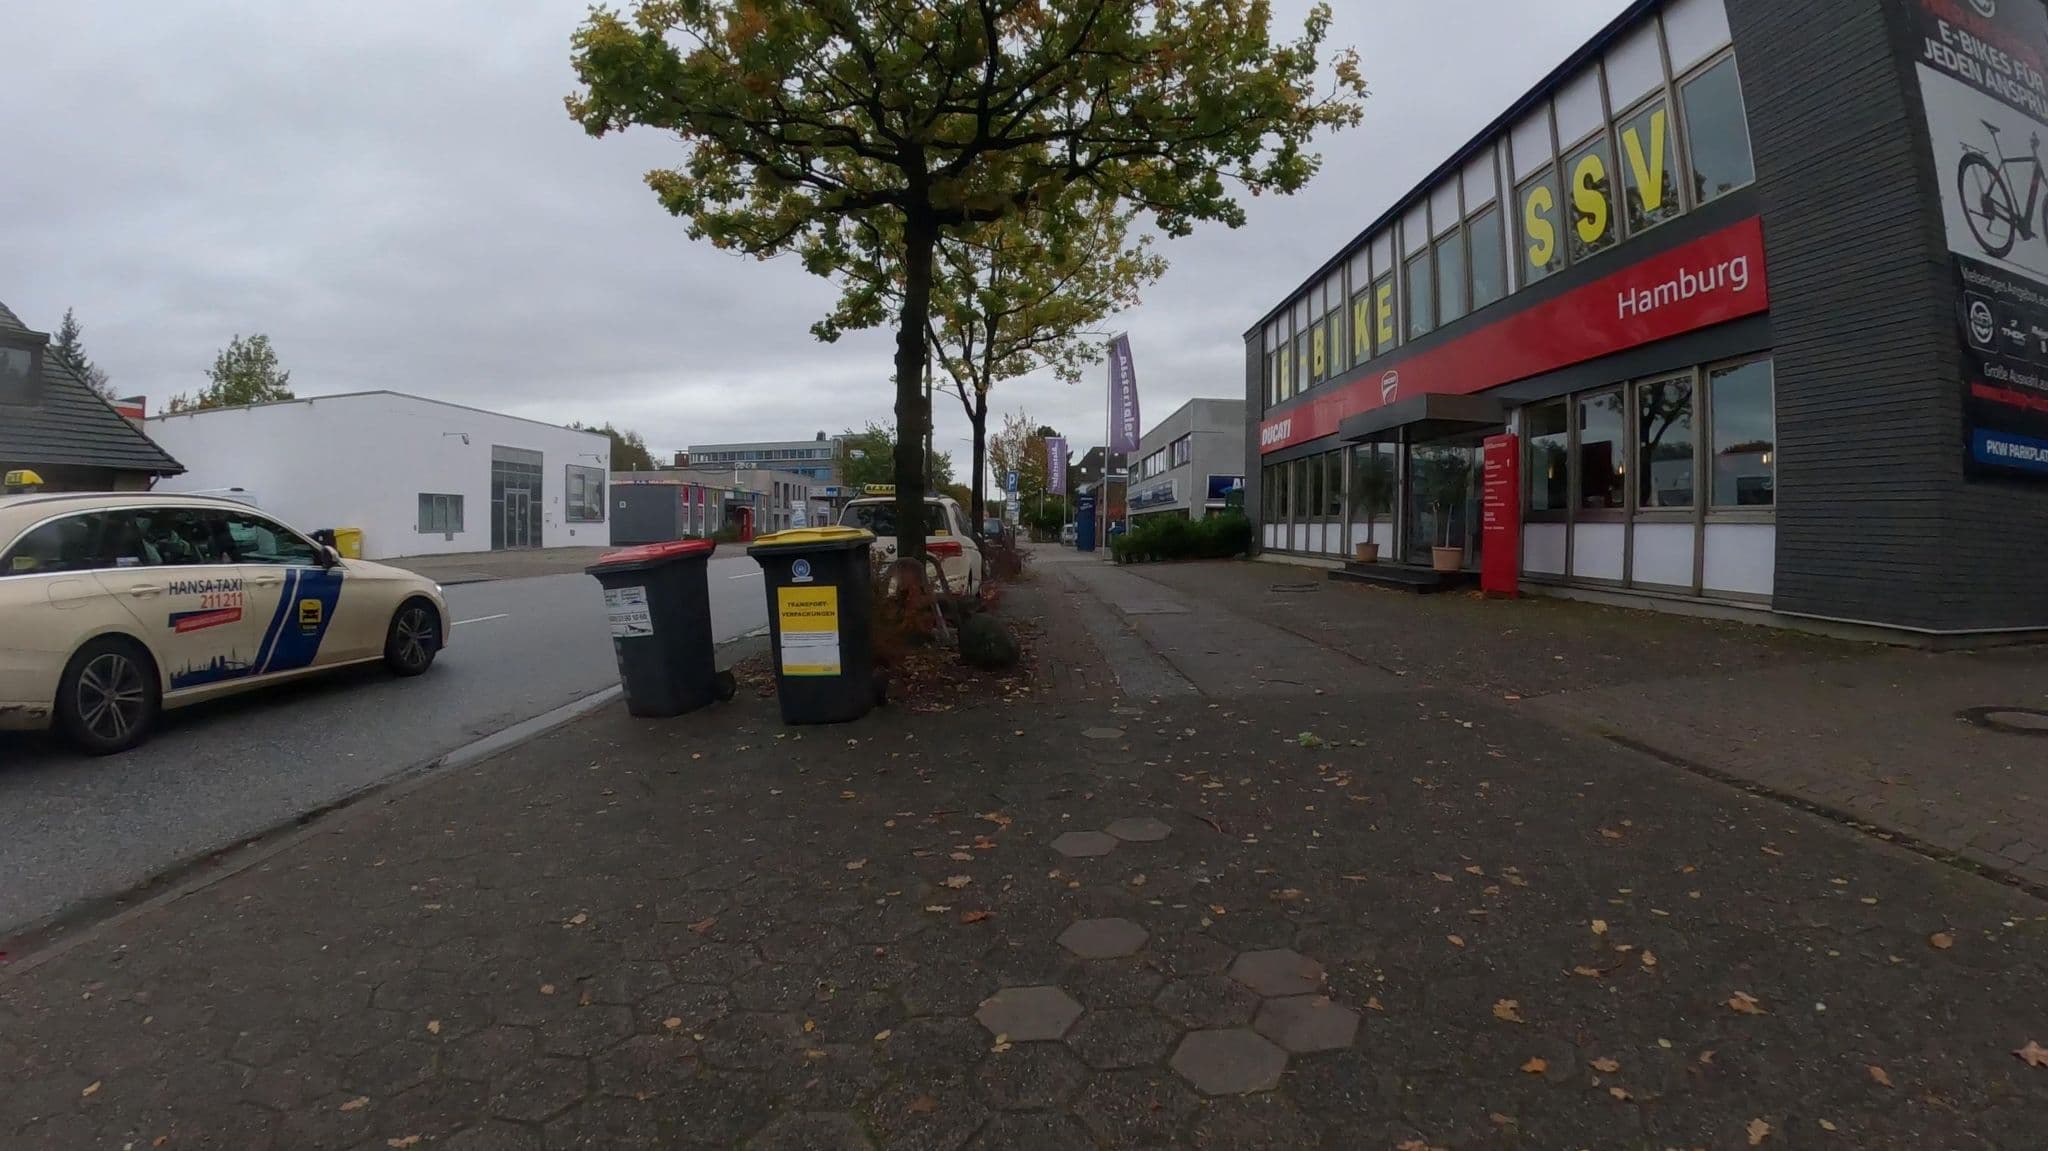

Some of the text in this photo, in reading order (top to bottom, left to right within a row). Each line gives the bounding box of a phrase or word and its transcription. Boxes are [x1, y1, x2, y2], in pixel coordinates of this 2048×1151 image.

[1924, 37, 1983, 84] JEDEN
[1938, 19, 2011, 75] E-BIKES
[1281, 108, 1665, 402] E-BIKE SSV
[1617, 255, 1749, 319] Hamburg
[1119, 355, 1135, 438] Alstertaler
[1261, 418, 1291, 445] DUCATI
[1986, 440, 2008, 456] PKW
[1008, 474, 1016, 490] P
[168, 578, 243, 595] HANSA-TAXI
[781, 610, 835, 618] VERPACKUNGEN
